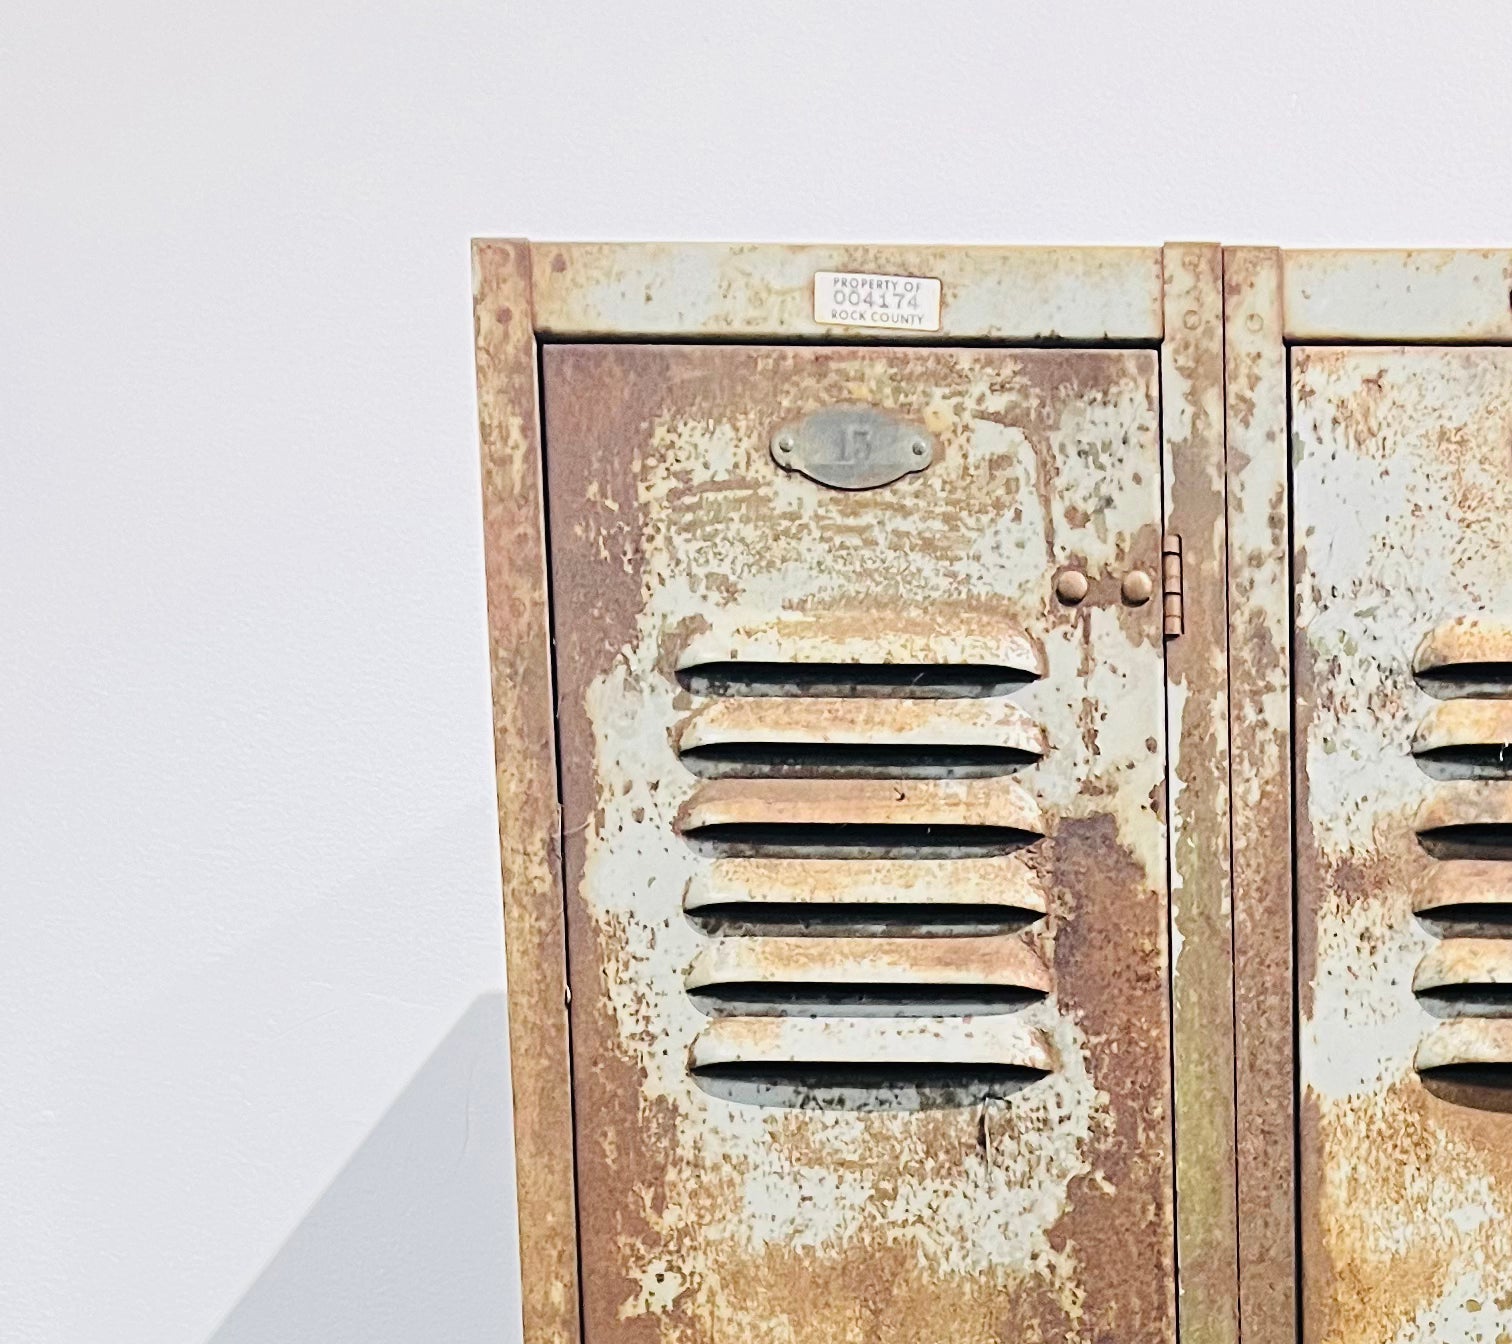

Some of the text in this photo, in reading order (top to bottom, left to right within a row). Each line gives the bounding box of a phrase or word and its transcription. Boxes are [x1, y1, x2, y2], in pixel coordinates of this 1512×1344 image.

[833, 277, 922, 294] PROPERTY OF
[833, 290, 919, 311] 004174
[831, 308, 925, 326] ROCK COUNTY
